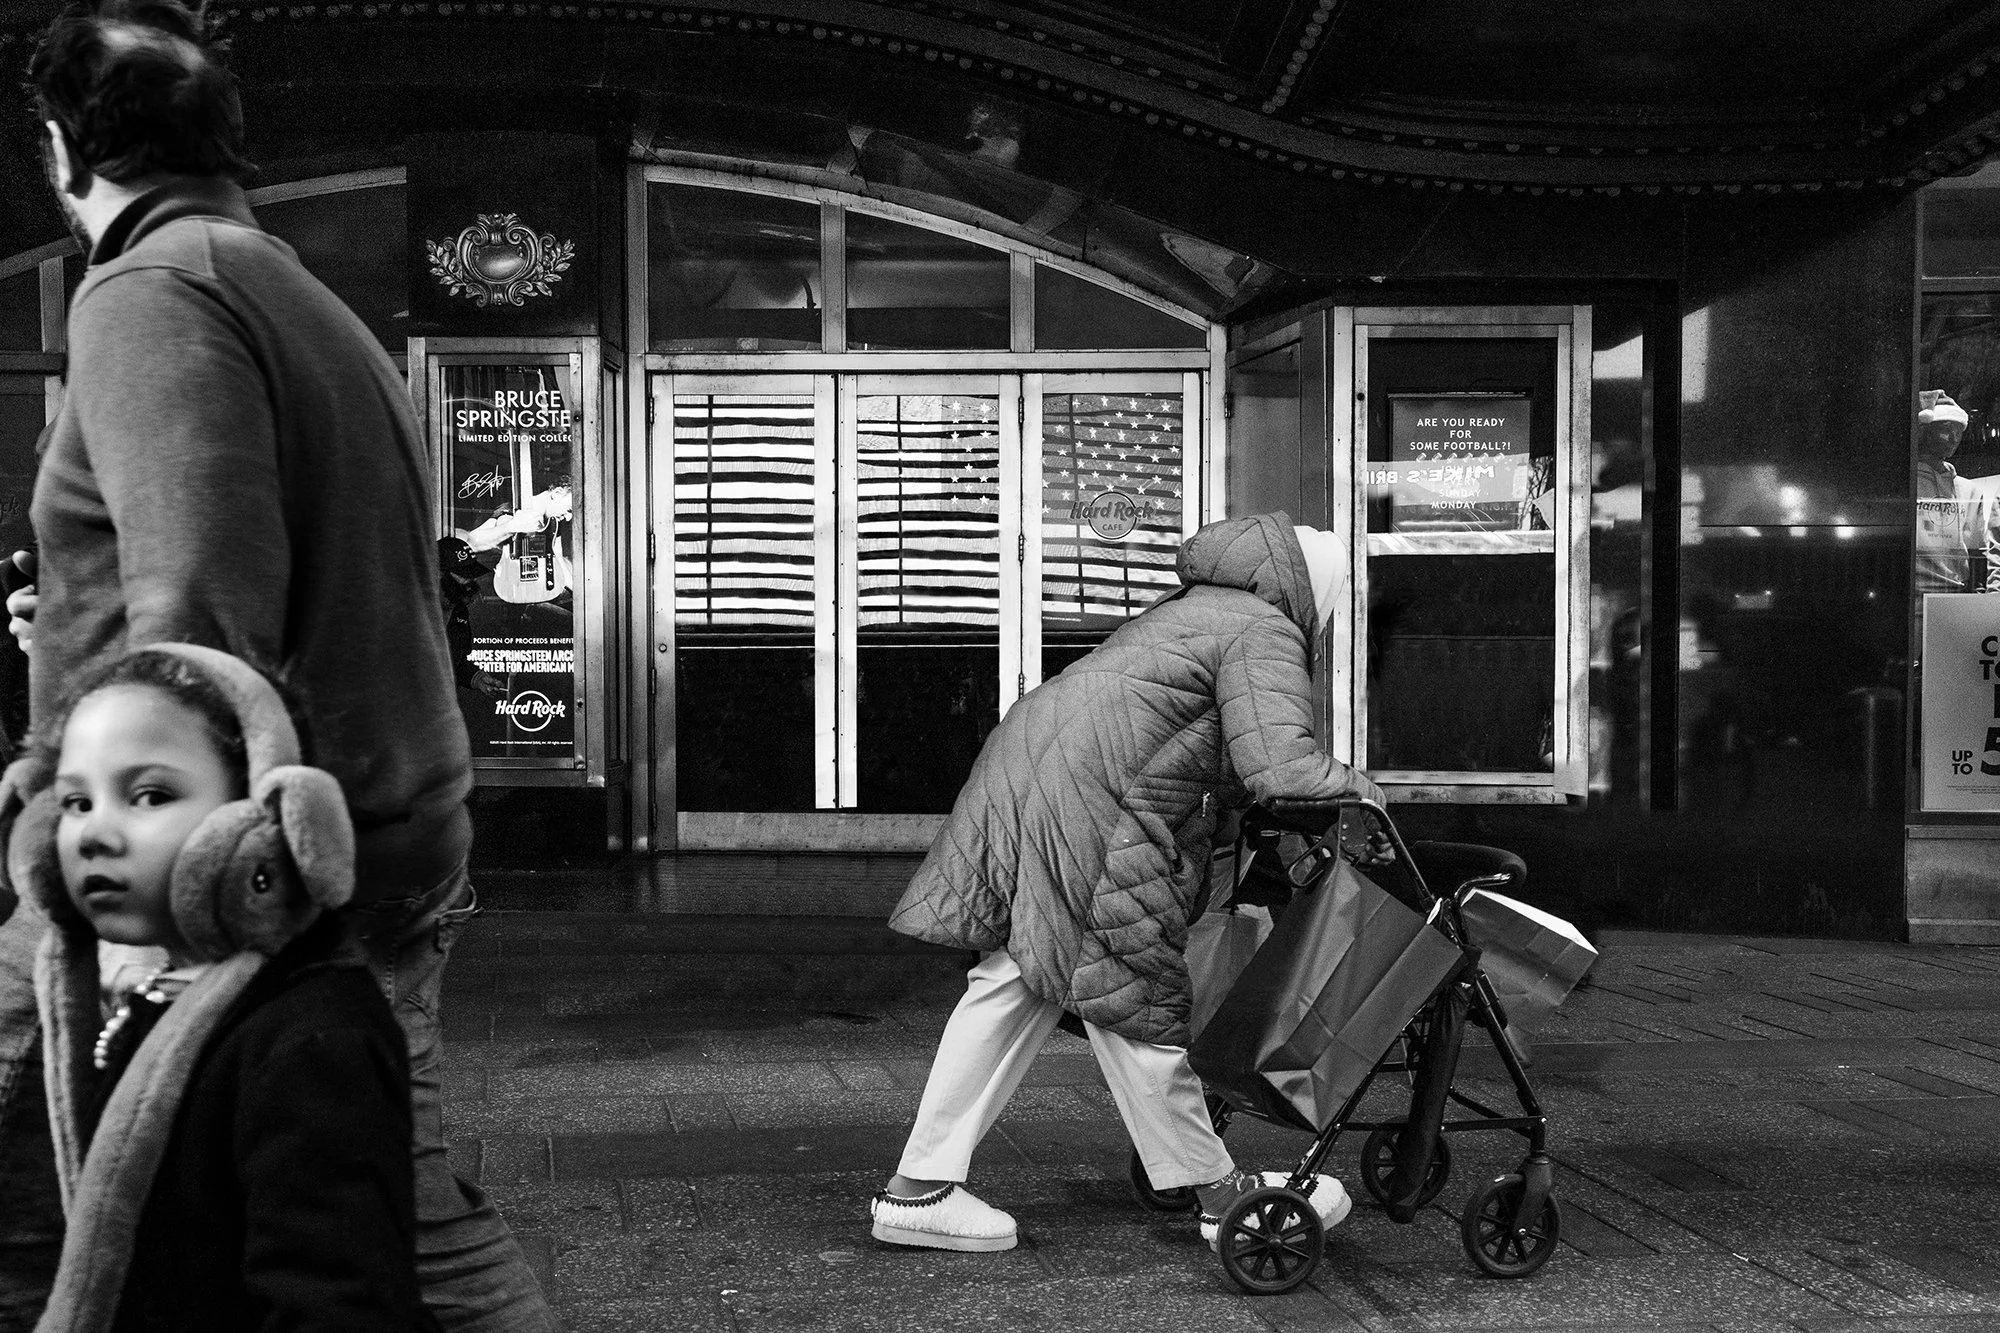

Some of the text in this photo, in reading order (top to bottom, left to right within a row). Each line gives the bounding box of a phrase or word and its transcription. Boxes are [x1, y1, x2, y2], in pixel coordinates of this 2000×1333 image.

[495, 390, 561, 408] BRUCE
[456, 409, 571, 428] SPRINGSTE
[1416, 418, 1505, 427] ARE YOU READY
[458, 434, 495, 442] LIMITED
[497, 434, 536, 442] EDITION
[1449, 430, 1472, 439] FOR
[1410, 441, 1511, 450] SOME FOOTBALL?!
[1431, 500, 1476, 509] MONDAY
[1070, 501, 1154, 521] Hard Rock
[1102, 523, 1123, 531] CAFE
[473, 637, 503, 645] PORTION
[504, 637, 514, 645] OF
[515, 637, 548, 645] PROCEEDS
[494, 649, 552, 662] SPRINGSTEEN
[506, 661, 523, 673] FOR
[523, 661, 567, 673] AMERICAN
[495, 700, 566, 718] Hard Rock
[1952, 750, 1973, 762] UP
[1952, 763, 1973, 775] TO
